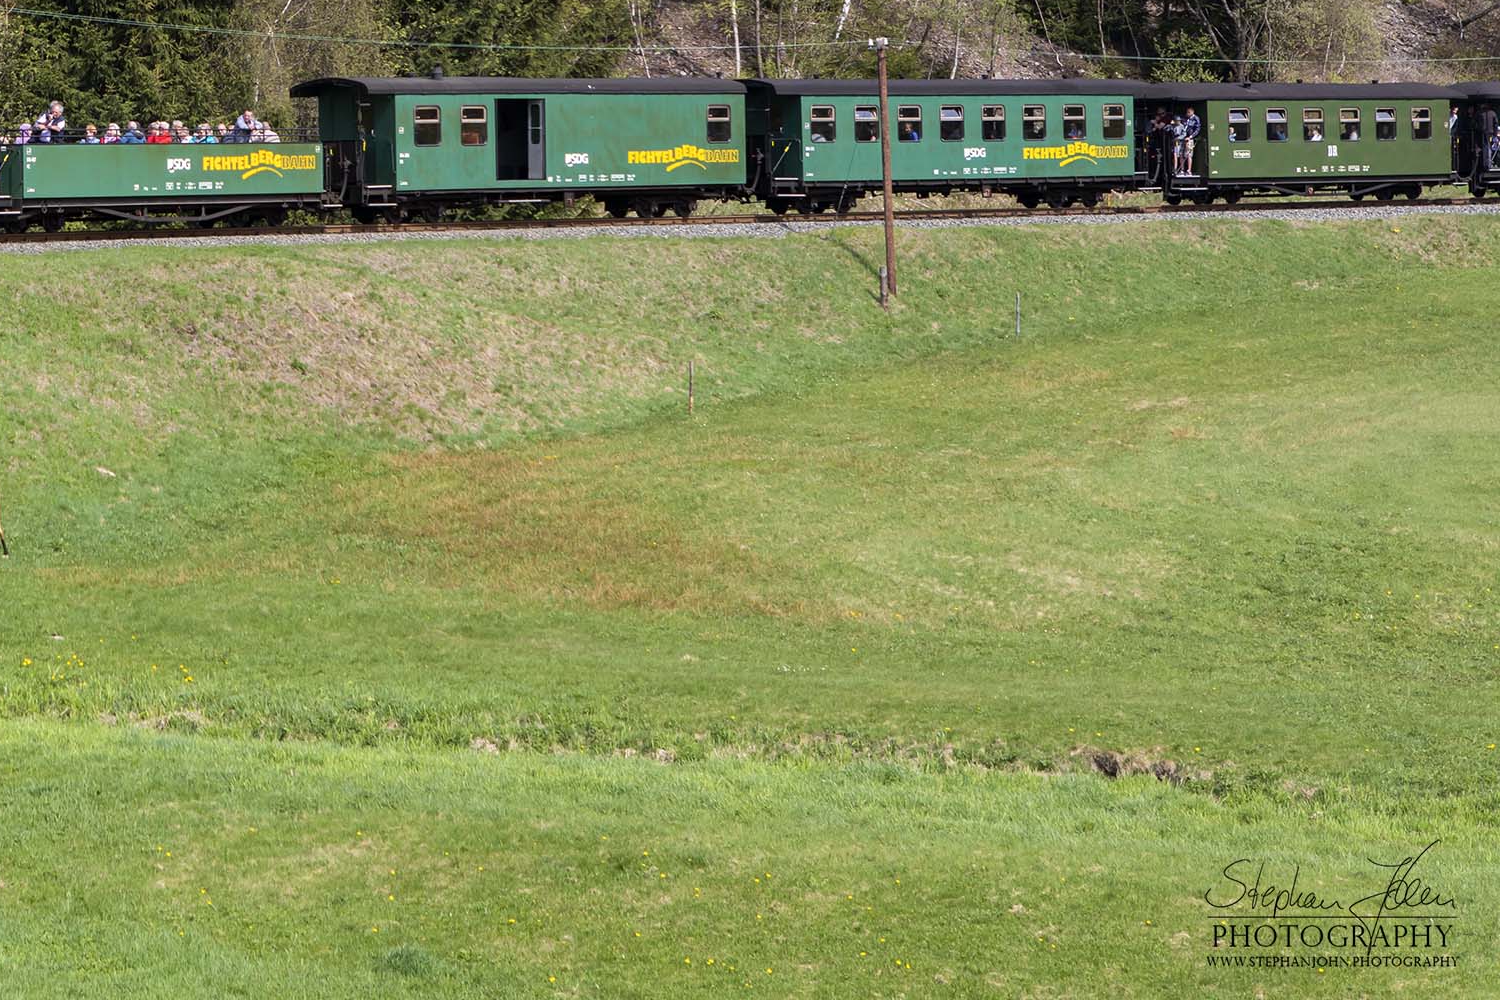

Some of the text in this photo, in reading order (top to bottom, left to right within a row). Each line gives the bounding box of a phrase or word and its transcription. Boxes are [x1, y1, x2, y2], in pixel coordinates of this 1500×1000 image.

[202, 149, 316, 171] FICHTELBERGBAHN
[627, 144, 740, 164] FICHTELBERGBAHN
[1022, 141, 1128, 160] FICHTELBERGBAHN
